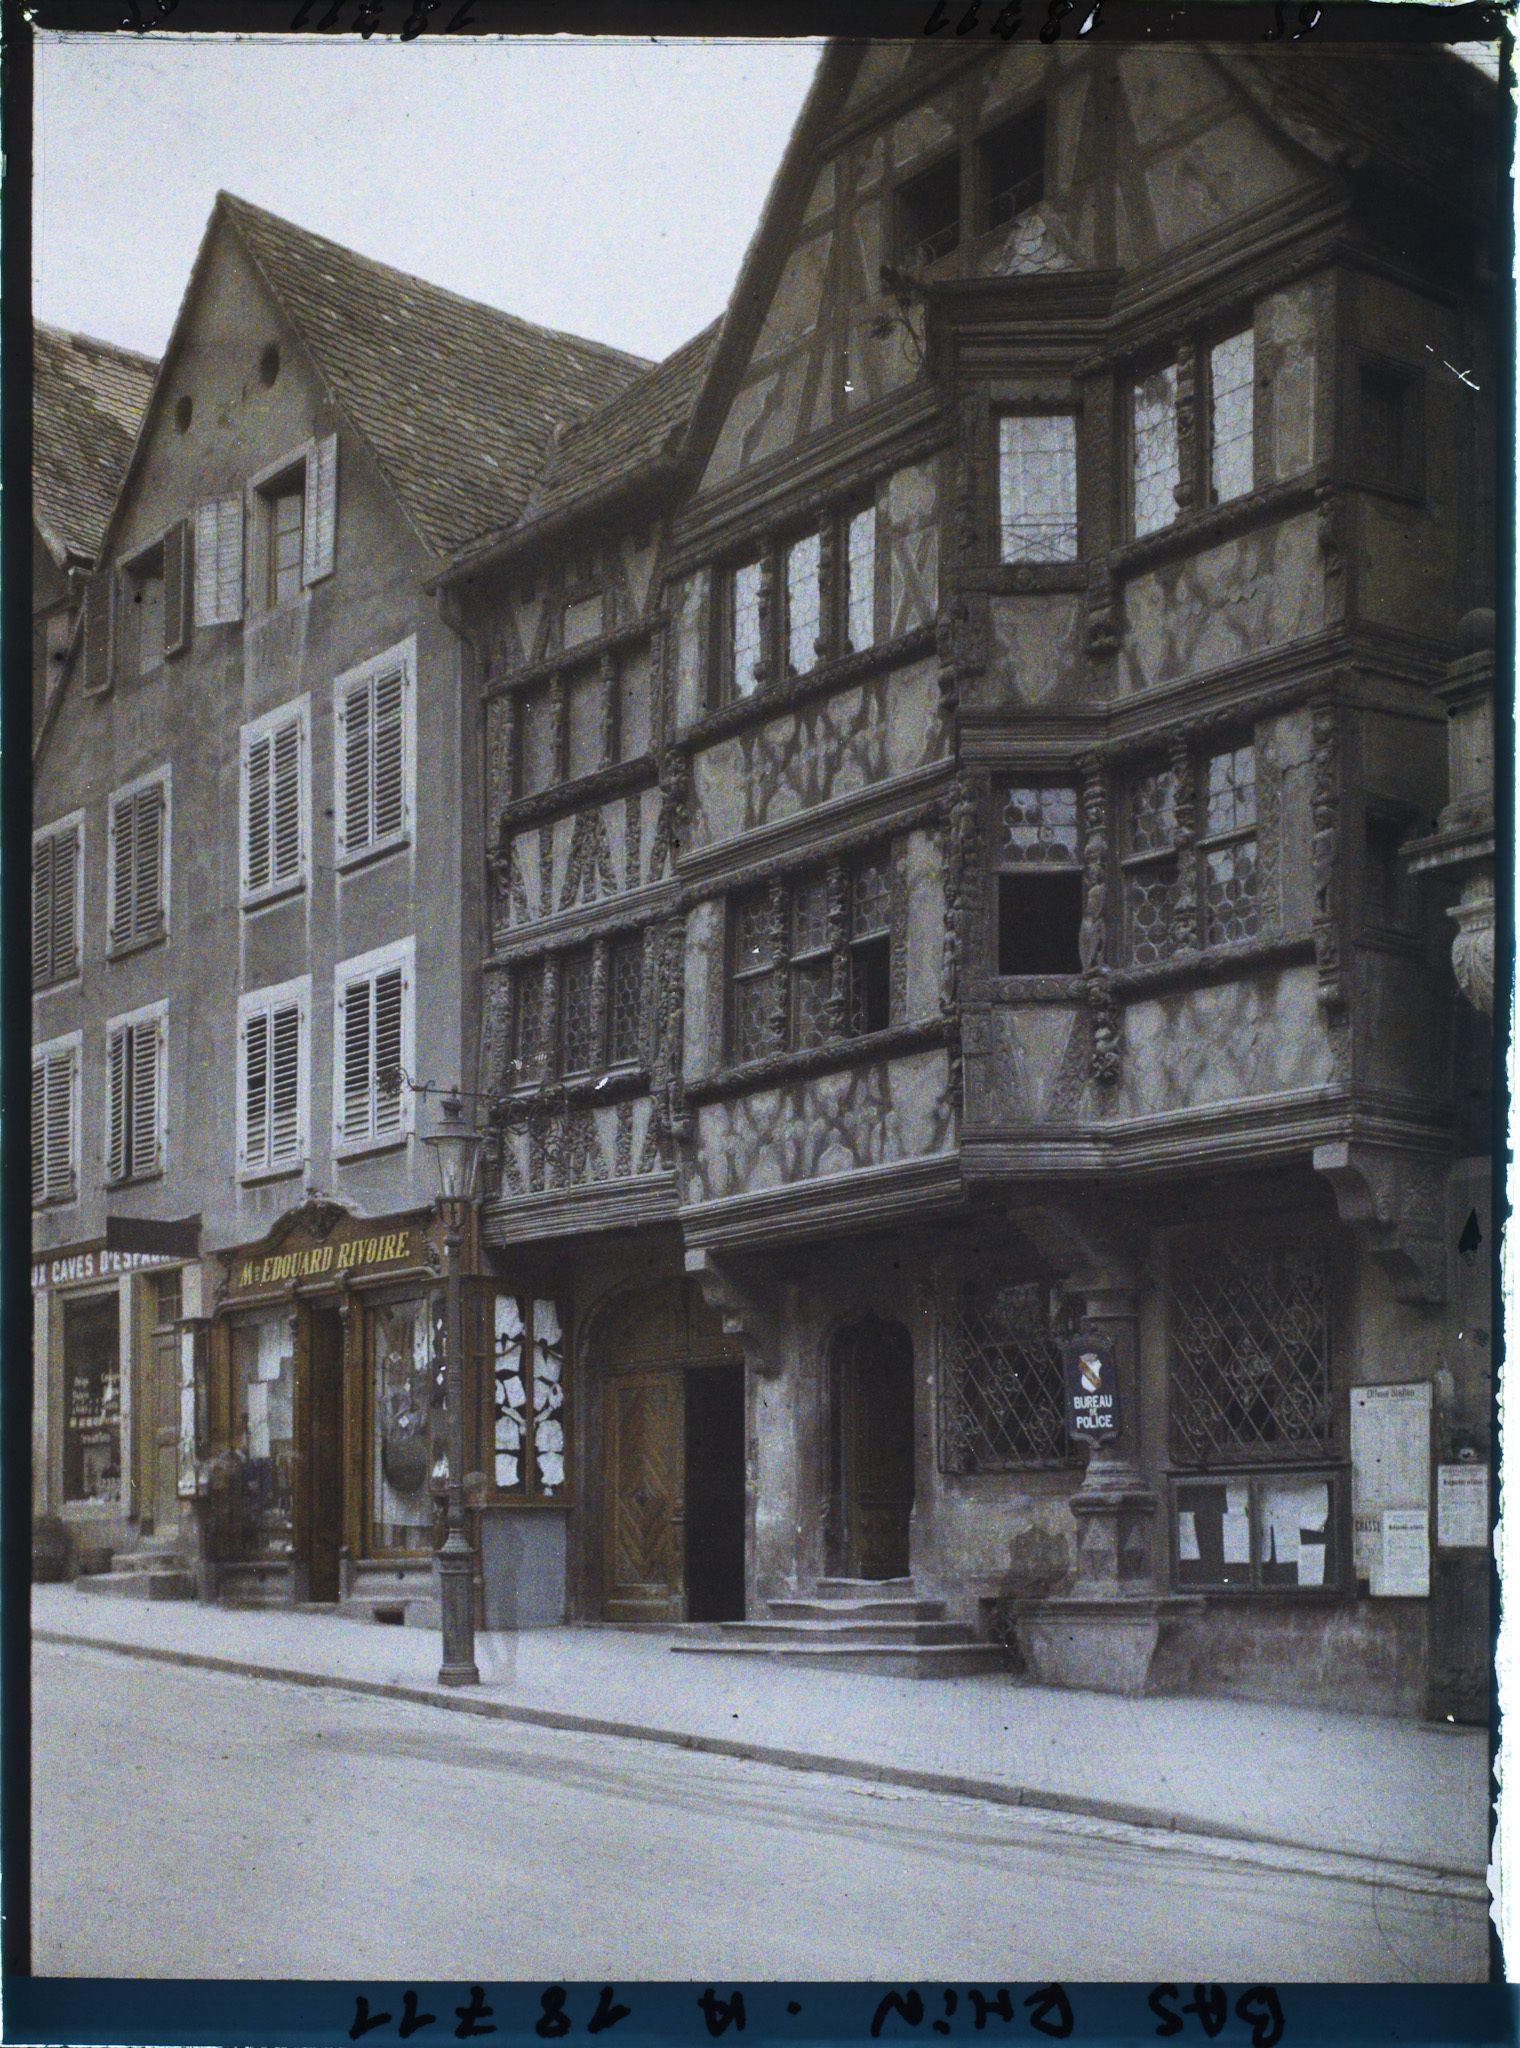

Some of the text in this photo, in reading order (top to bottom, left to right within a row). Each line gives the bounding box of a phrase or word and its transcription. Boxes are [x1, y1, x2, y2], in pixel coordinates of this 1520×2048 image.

[52, 1253, 94, 1283] CAVES
[261, 1246, 333, 1283] EDOUARD
[336, 1231, 411, 1269] RIVOIRE.
[1073, 1394, 1113, 1409] BUREAU
[1076, 1414, 1113, 1429] POLICE
[1148, 1984, 1288, 2048] BAS
